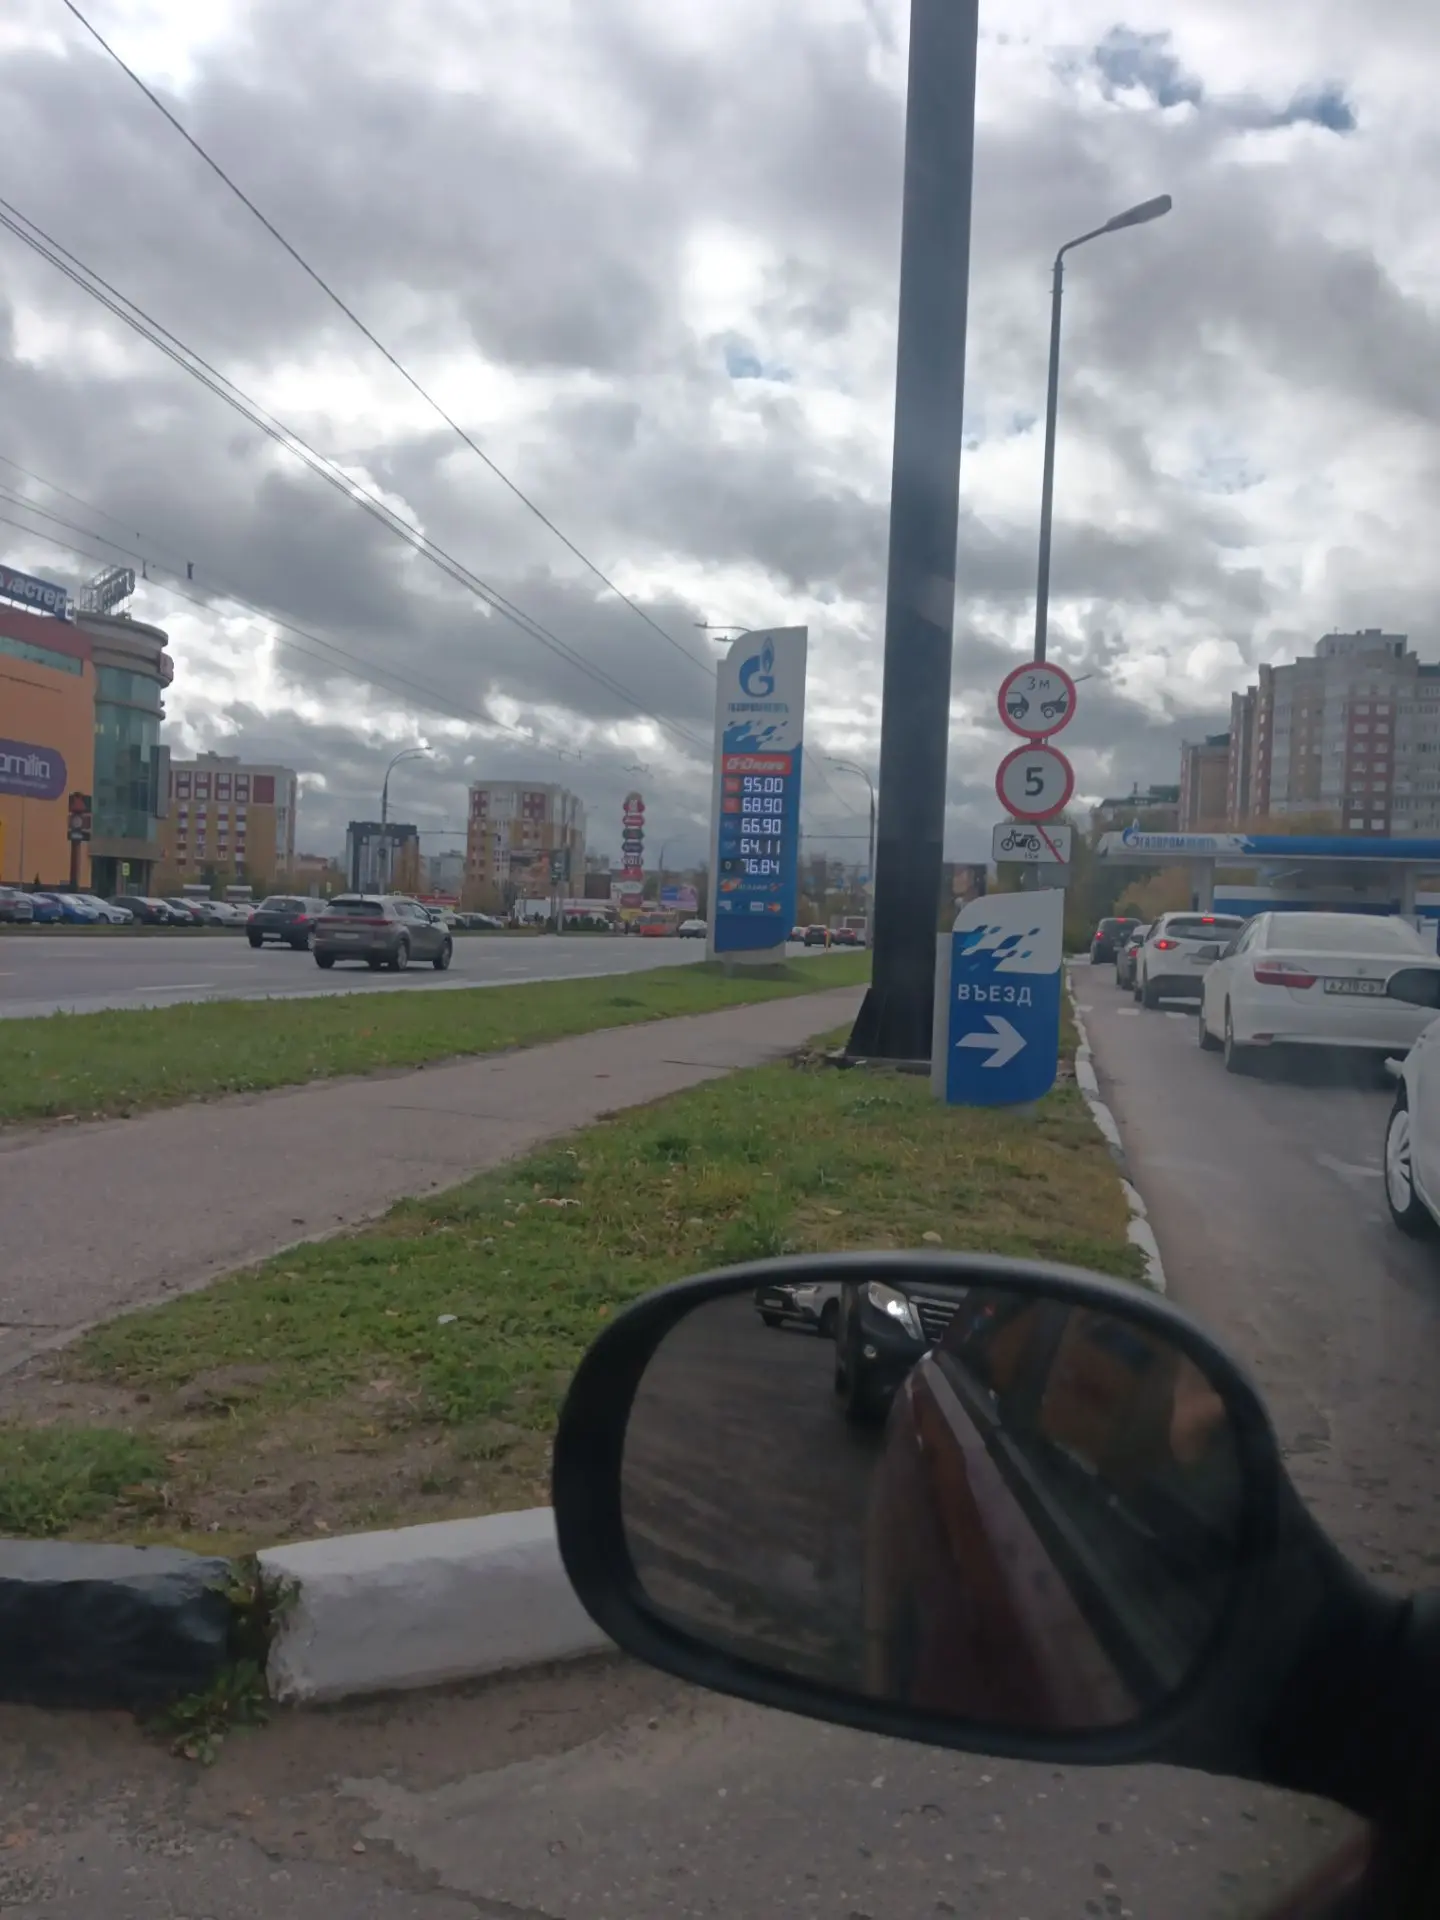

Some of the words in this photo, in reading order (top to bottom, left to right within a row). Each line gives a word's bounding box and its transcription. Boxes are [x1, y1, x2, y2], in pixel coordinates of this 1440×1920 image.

[1027, 676, 1037, 691] 3
[1024, 766, 1045, 797] 5
[742, 797, 782, 813] 68.90
[741, 818, 781, 834] 66.90
[740, 838, 781, 856] 64.11
[741, 858, 780, 875] 76.84
[957, 983, 1032, 1007] ВЪЕЗД
